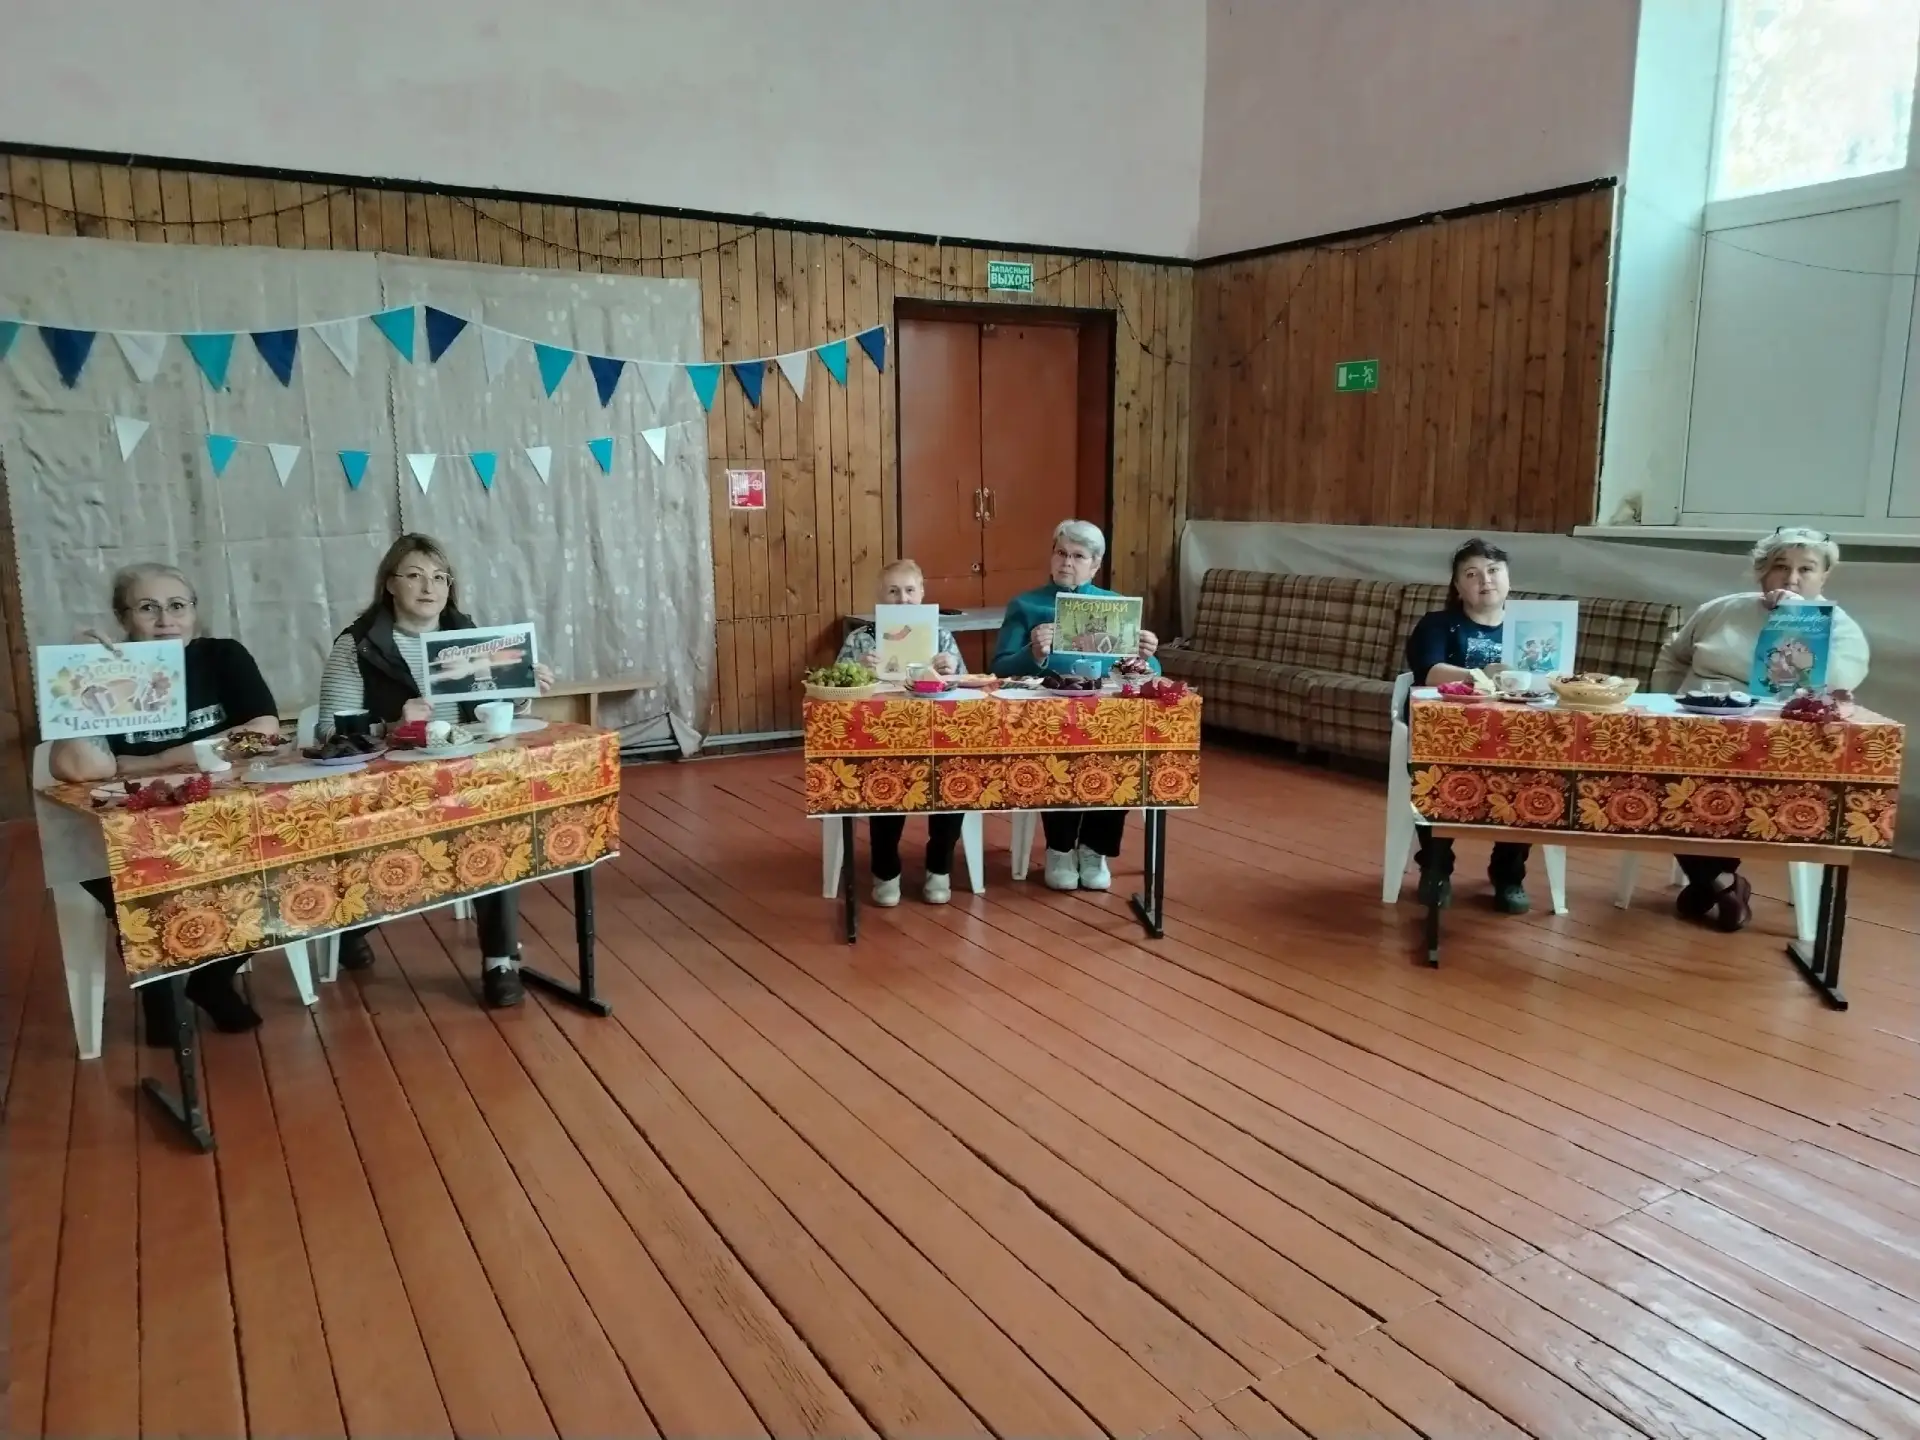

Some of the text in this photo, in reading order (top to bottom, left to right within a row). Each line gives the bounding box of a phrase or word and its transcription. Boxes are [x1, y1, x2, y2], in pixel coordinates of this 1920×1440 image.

[991, 265, 1030, 274] ЗАПАСНЫЙ
[991, 272, 1030, 289] ВЫХОД
[1064, 600, 1129, 613] ЧАСТУШКИ
